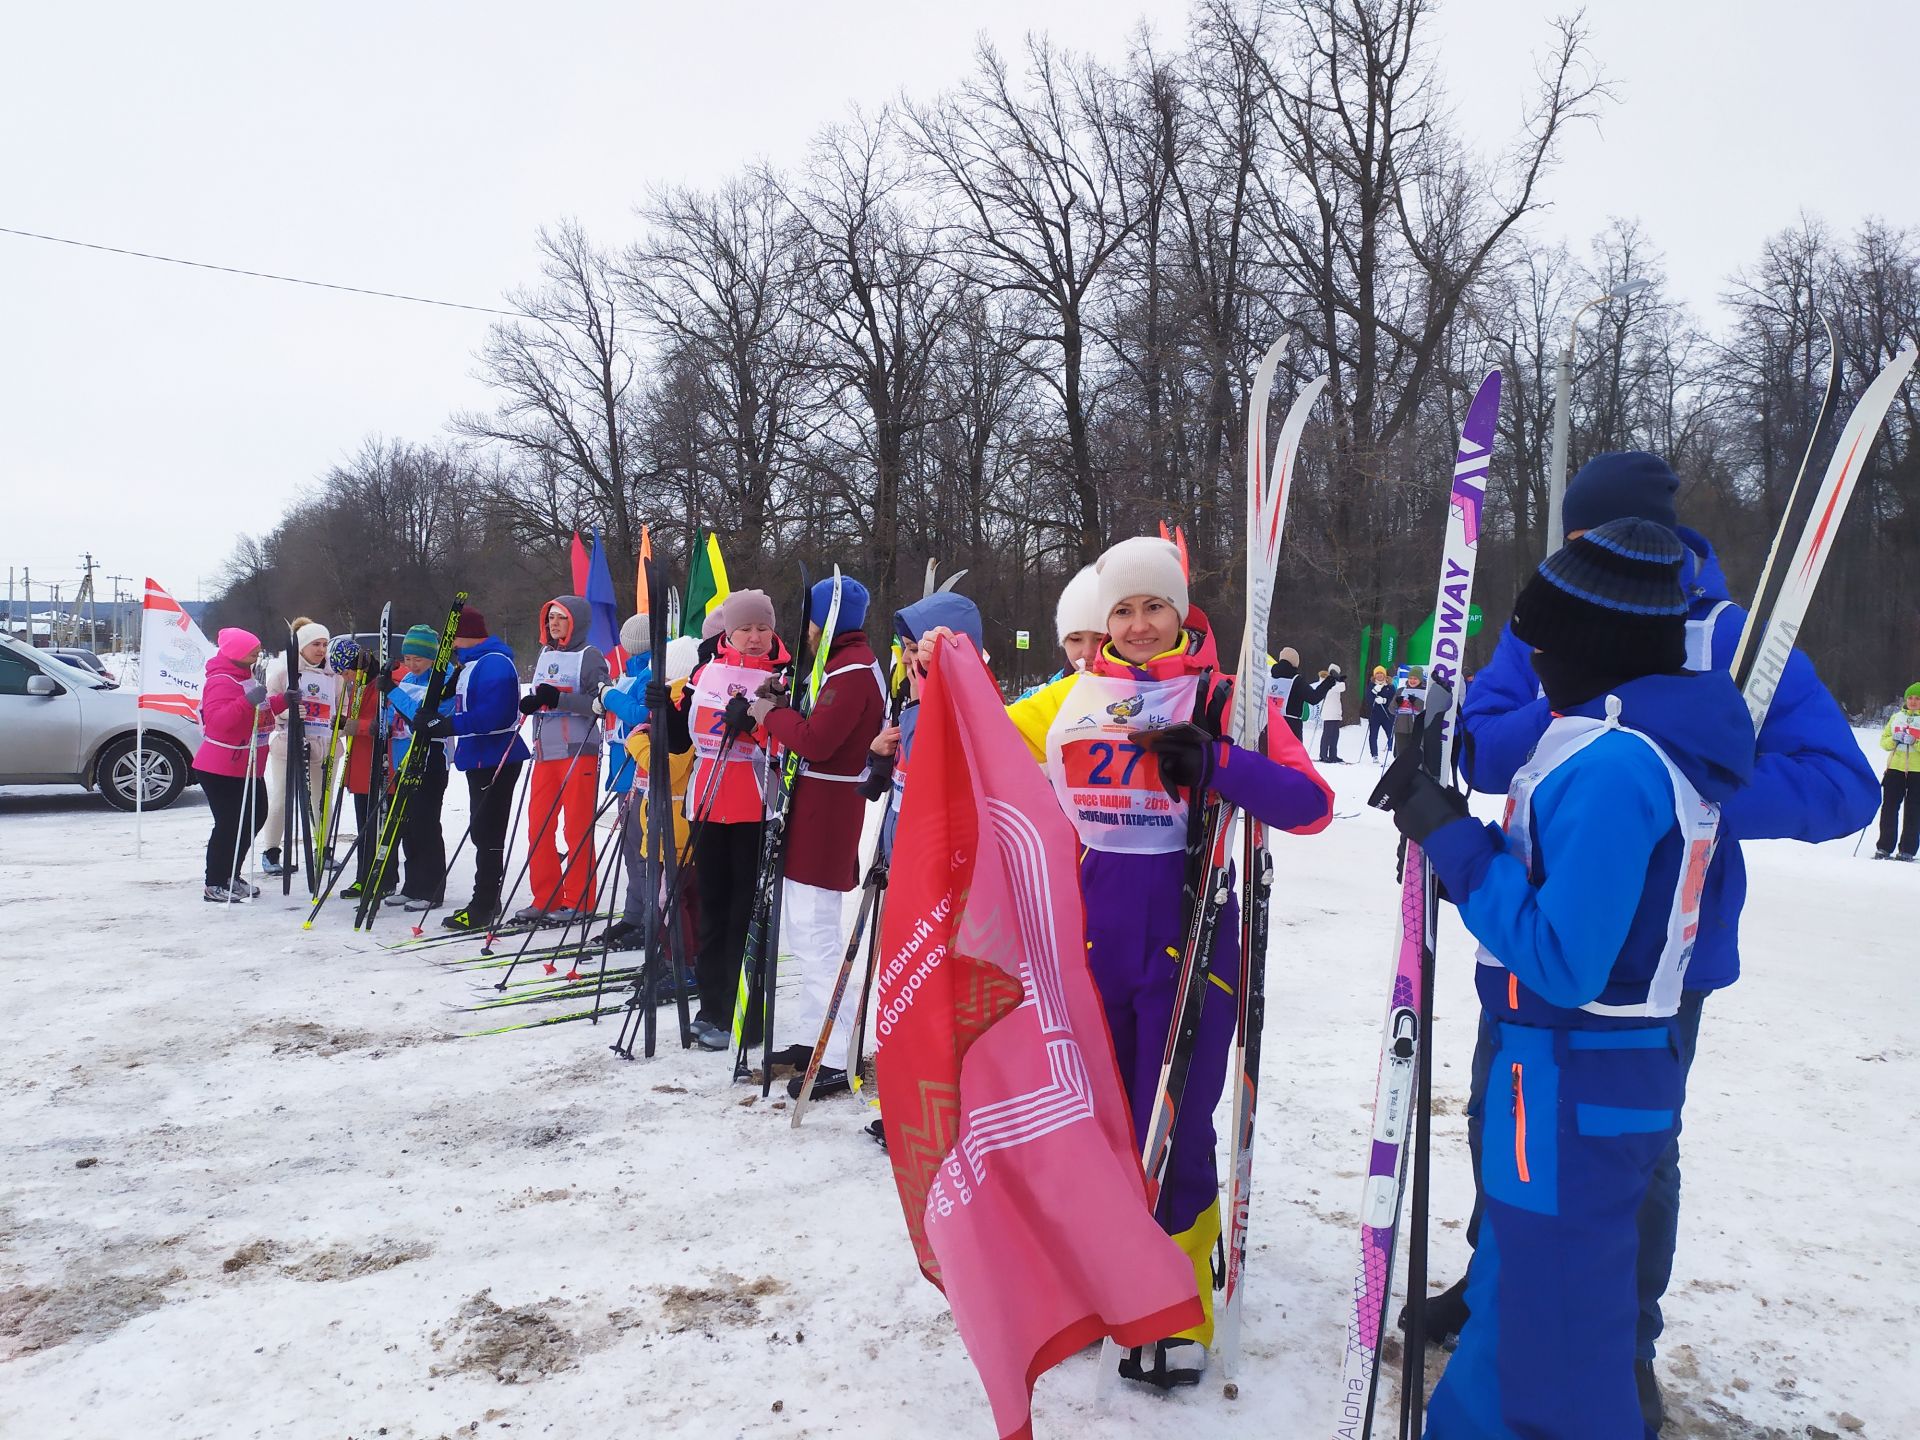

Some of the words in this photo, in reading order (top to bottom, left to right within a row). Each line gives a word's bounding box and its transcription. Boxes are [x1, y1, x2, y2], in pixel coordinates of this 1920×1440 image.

[436, 611, 457, 673] FISCHER
[1088, 742, 1146, 785] 27
[1098, 794, 1131, 809] НАЦИИ
[1144, 797, 1170, 810] 2019
[1120, 813, 1174, 827] ТАТАРСТАН
[880, 944, 948, 1036] обороне»
